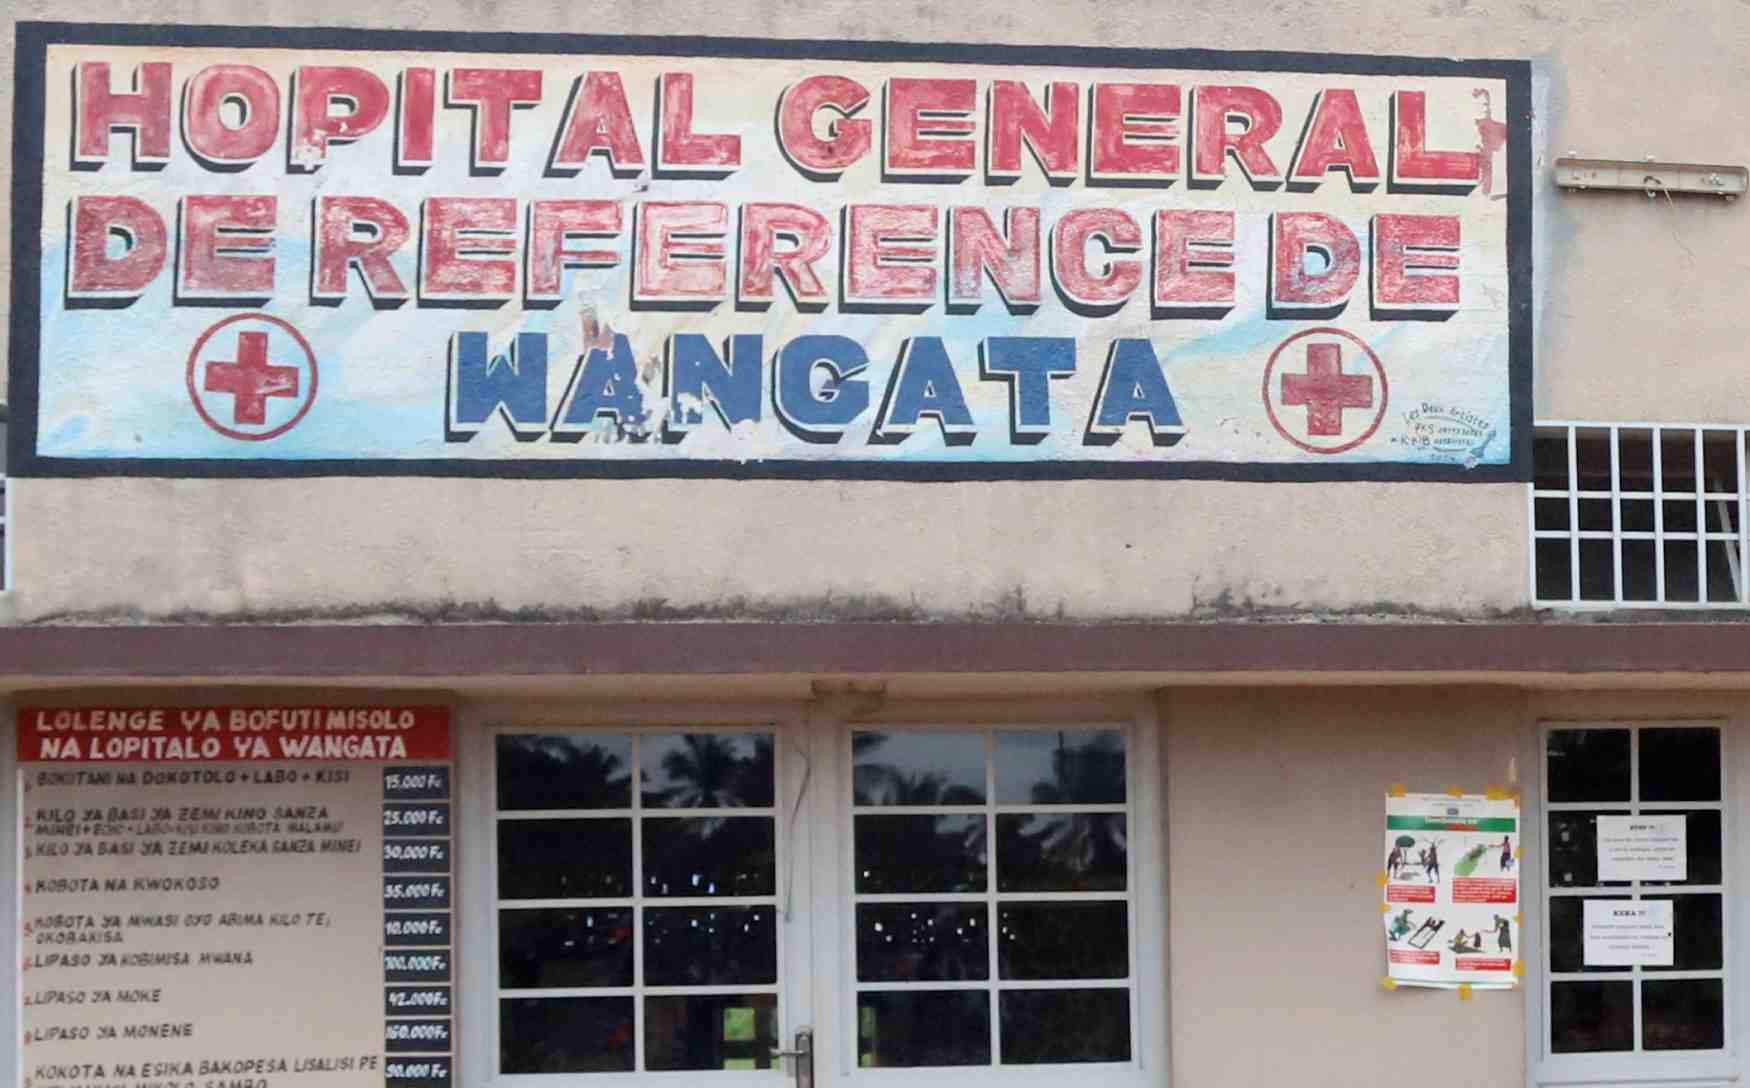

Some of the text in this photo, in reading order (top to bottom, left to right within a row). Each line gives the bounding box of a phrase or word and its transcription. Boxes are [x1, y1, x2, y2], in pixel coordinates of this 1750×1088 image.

[70, 62, 1482, 194] HOPITAL GENERAL
[64, 196, 1460, 321] DE REFERENCE DE
[445, 331, 1186, 446] WANGATA
[36, 709, 415, 732] LOLENGE YA BOFUTI MISOLO
[40, 735, 408, 760] NA LOPITALO YA WANGATA
[253, 770, 298, 784] LABO
[315, 770, 350, 784] KISI
[35, 808, 75, 823] KILO
